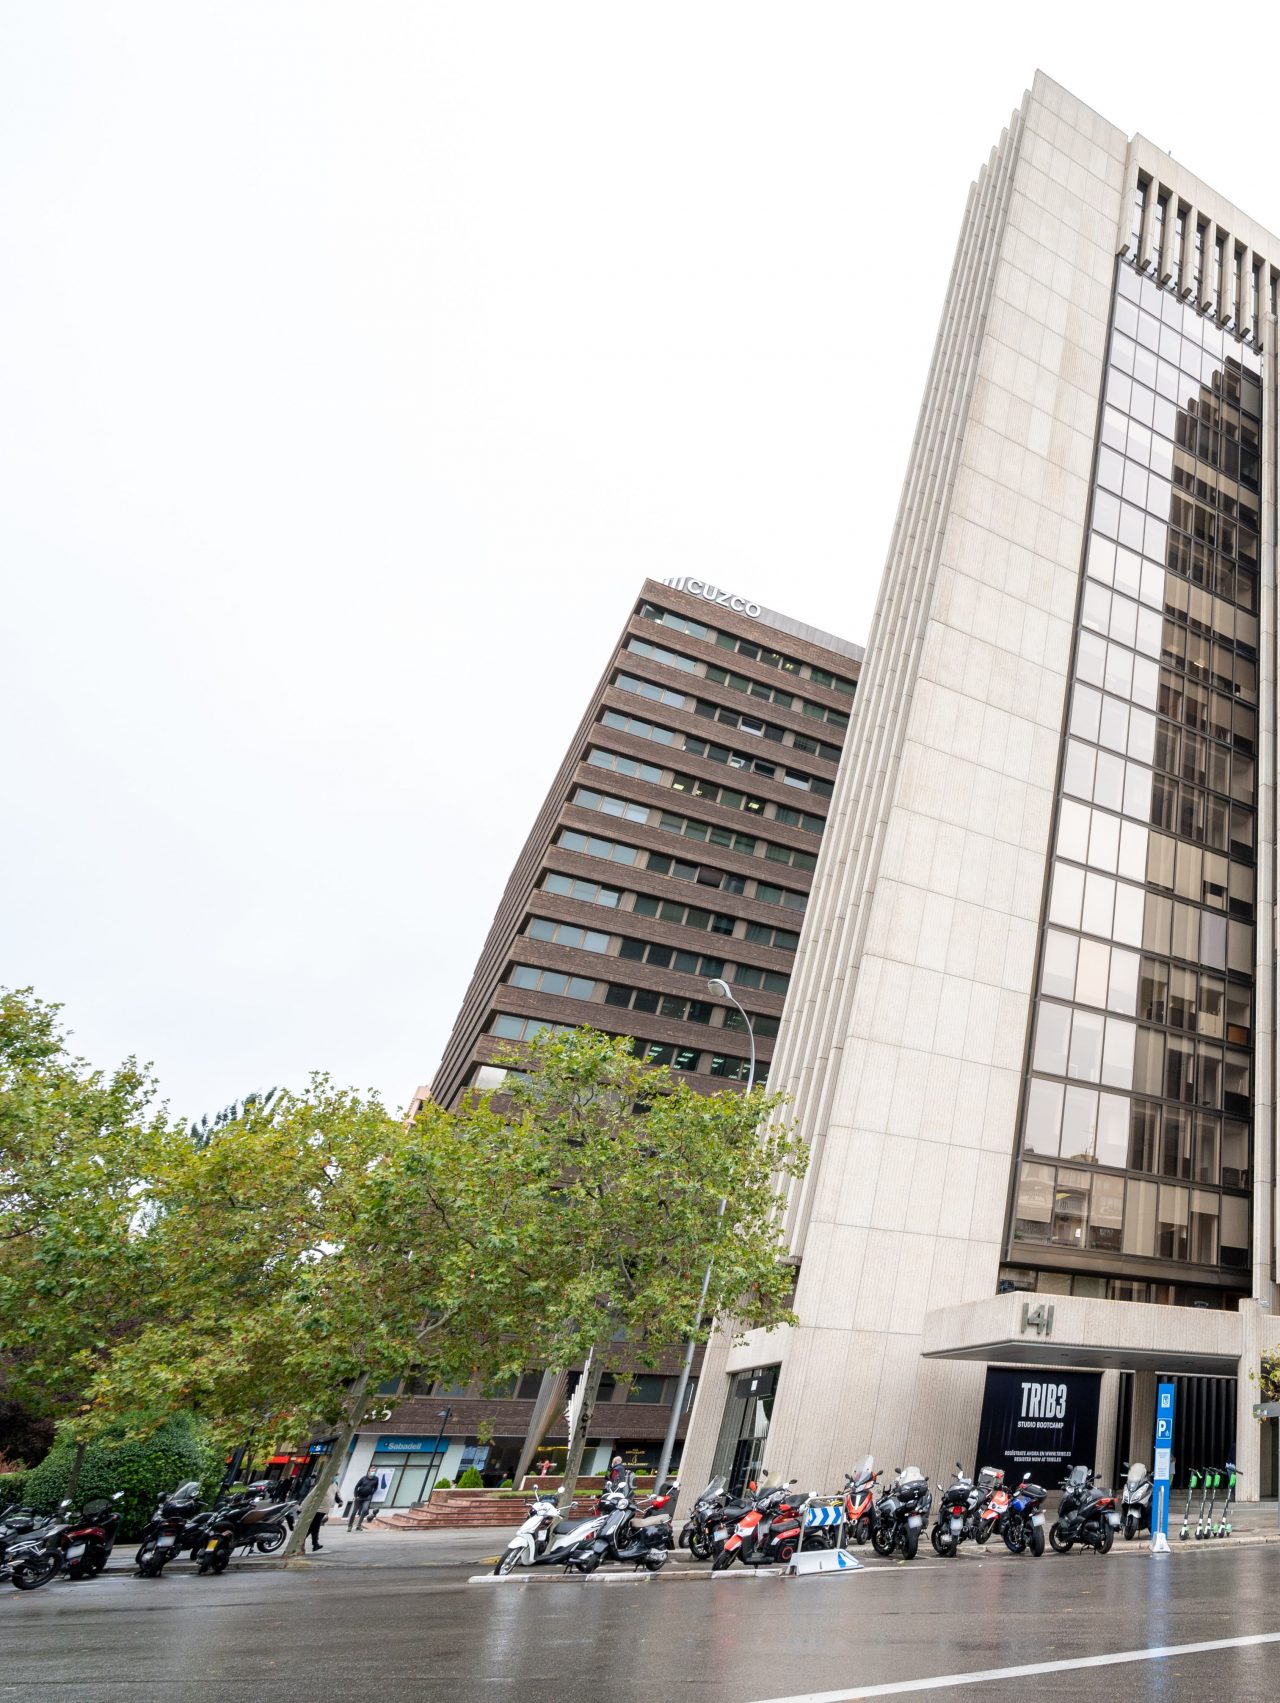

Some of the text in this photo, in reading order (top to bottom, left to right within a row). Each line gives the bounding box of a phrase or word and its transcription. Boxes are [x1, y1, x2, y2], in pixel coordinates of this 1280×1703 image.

[687, 579, 761, 618] CUZCO
[1021, 1303, 1055, 1336] 141
[1021, 1382, 1068, 1419] TRIB3
[1036, 1421, 1064, 1429] BOOTCAMP
[1159, 1420, 1167, 1437] P
[388, 1442, 422, 1450] Sabadell
